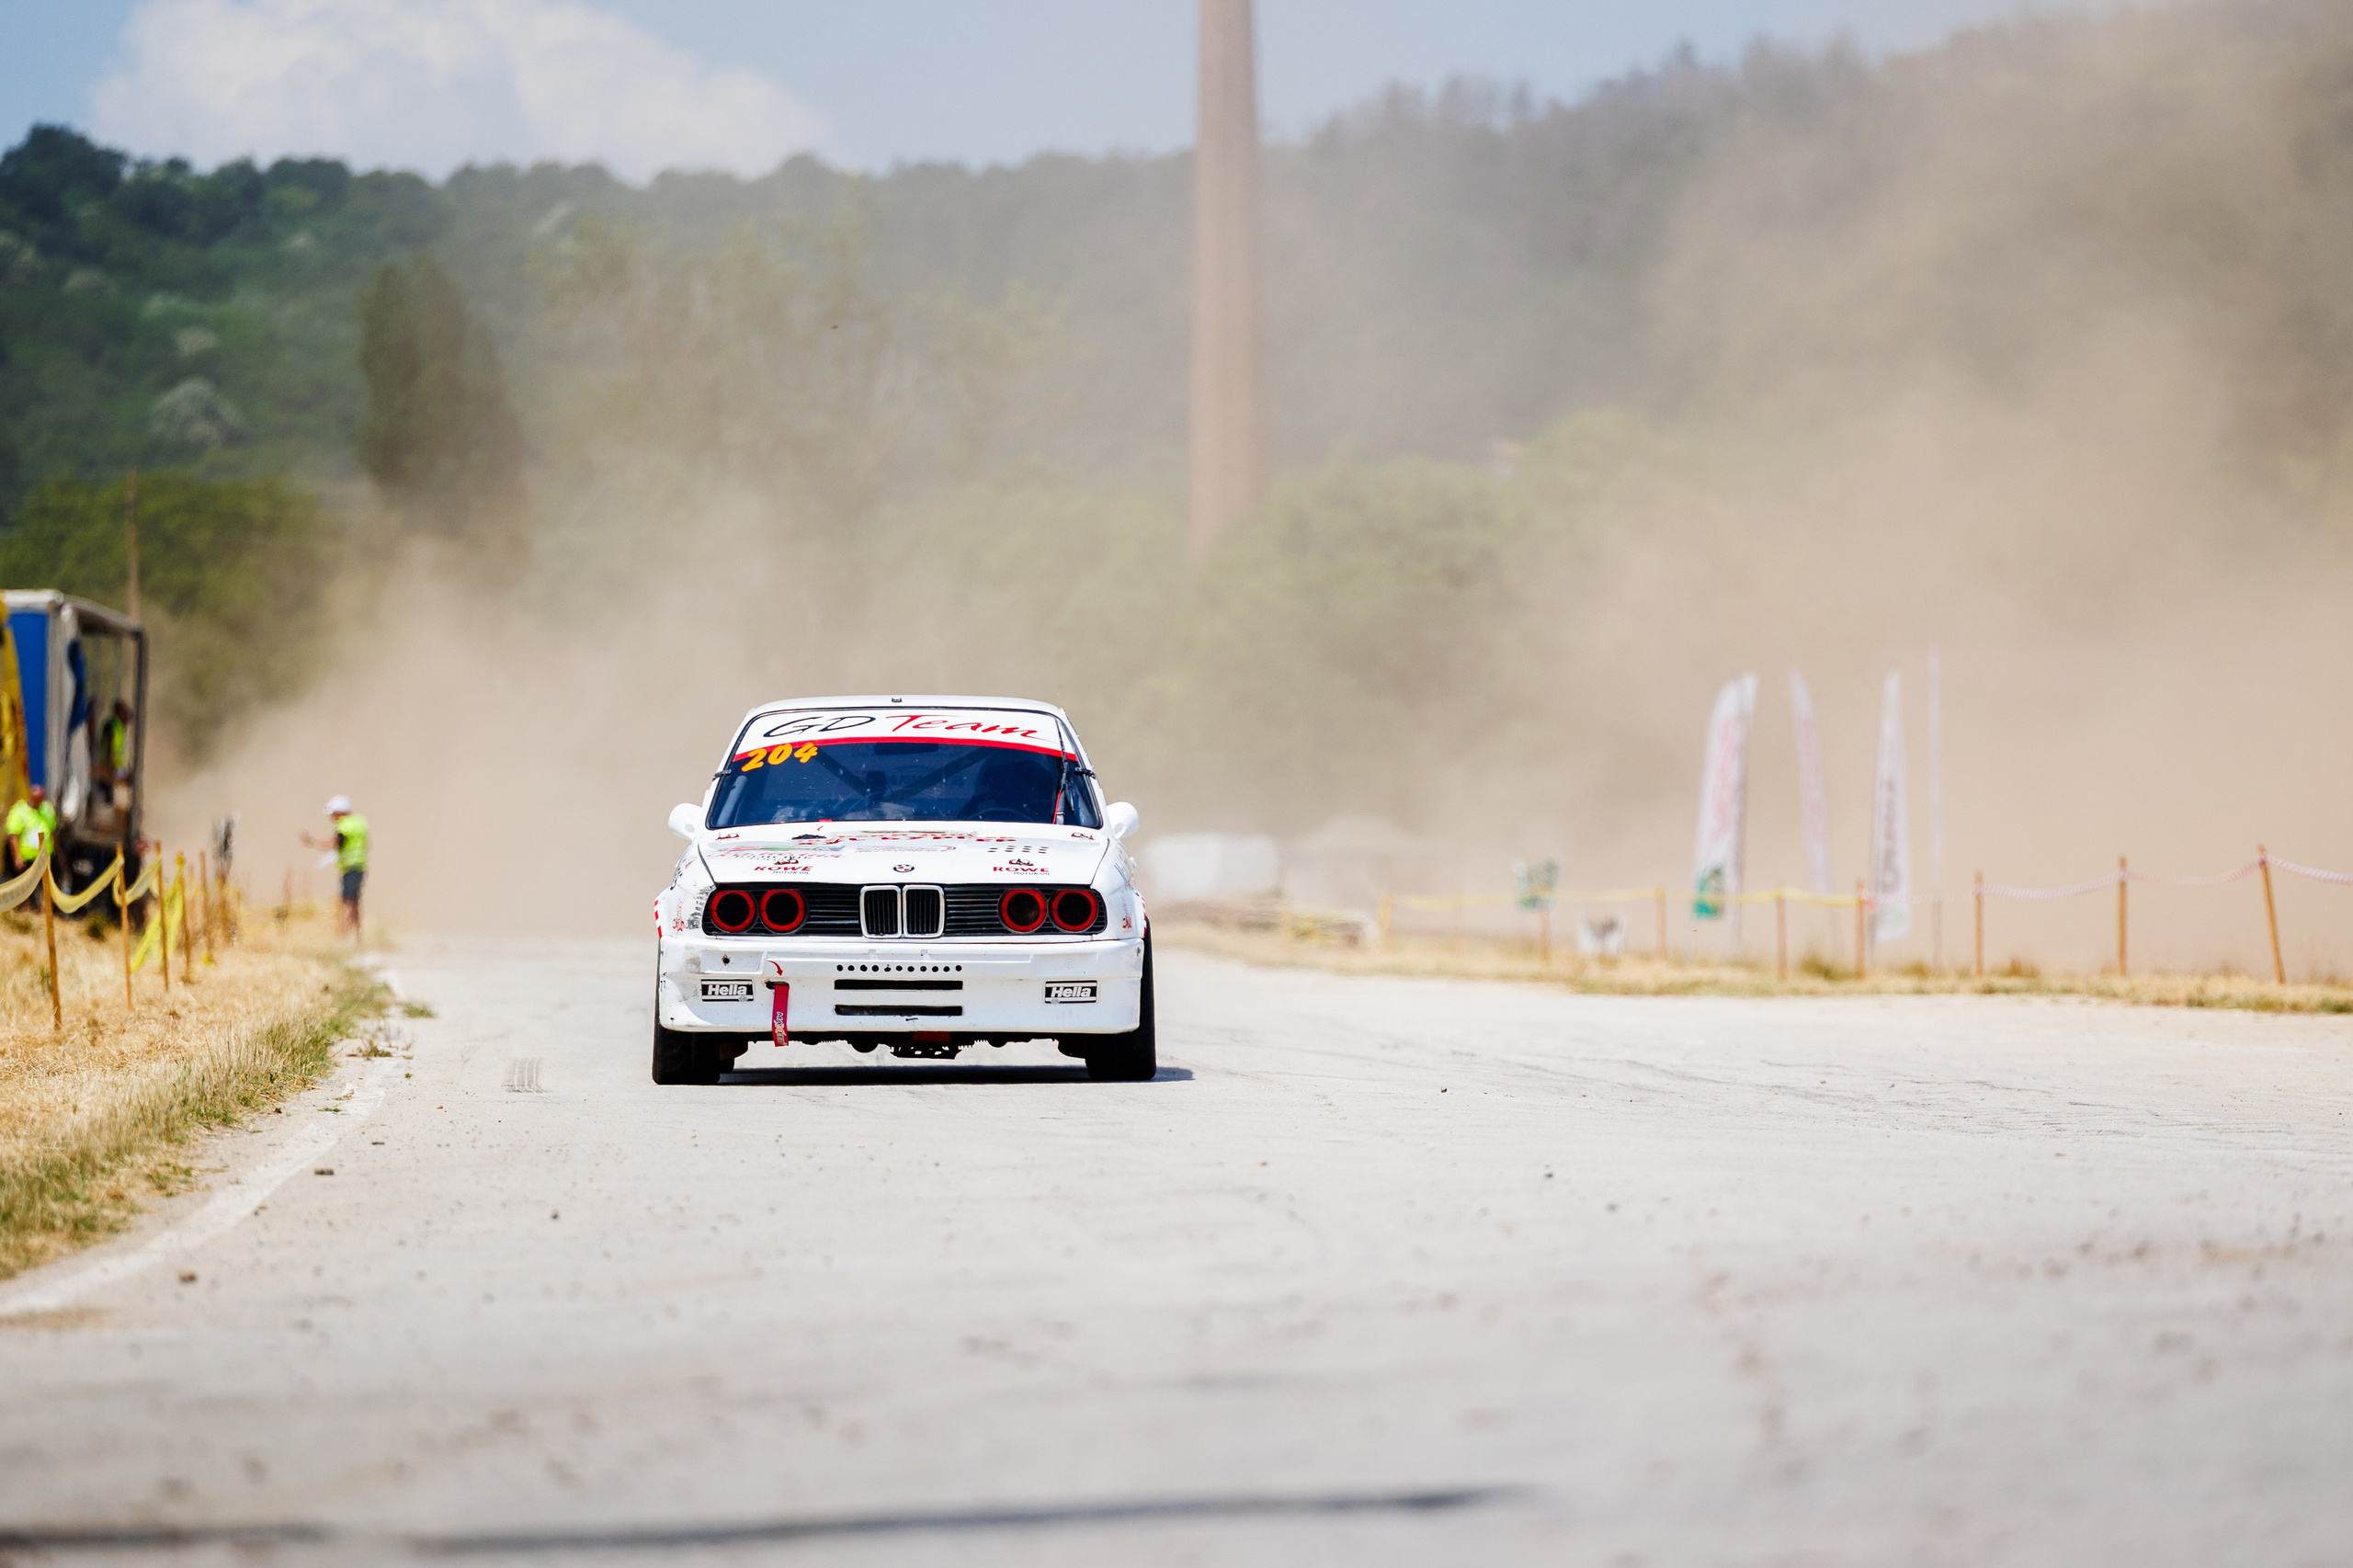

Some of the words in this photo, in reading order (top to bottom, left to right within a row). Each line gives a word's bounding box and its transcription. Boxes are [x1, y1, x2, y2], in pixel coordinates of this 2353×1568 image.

[762, 715, 876, 738] GD
[885, 714, 1047, 741] Team
[741, 742, 818, 772] 204
[708, 984, 747, 995] Hella
[1051, 986, 1091, 997] Hella
